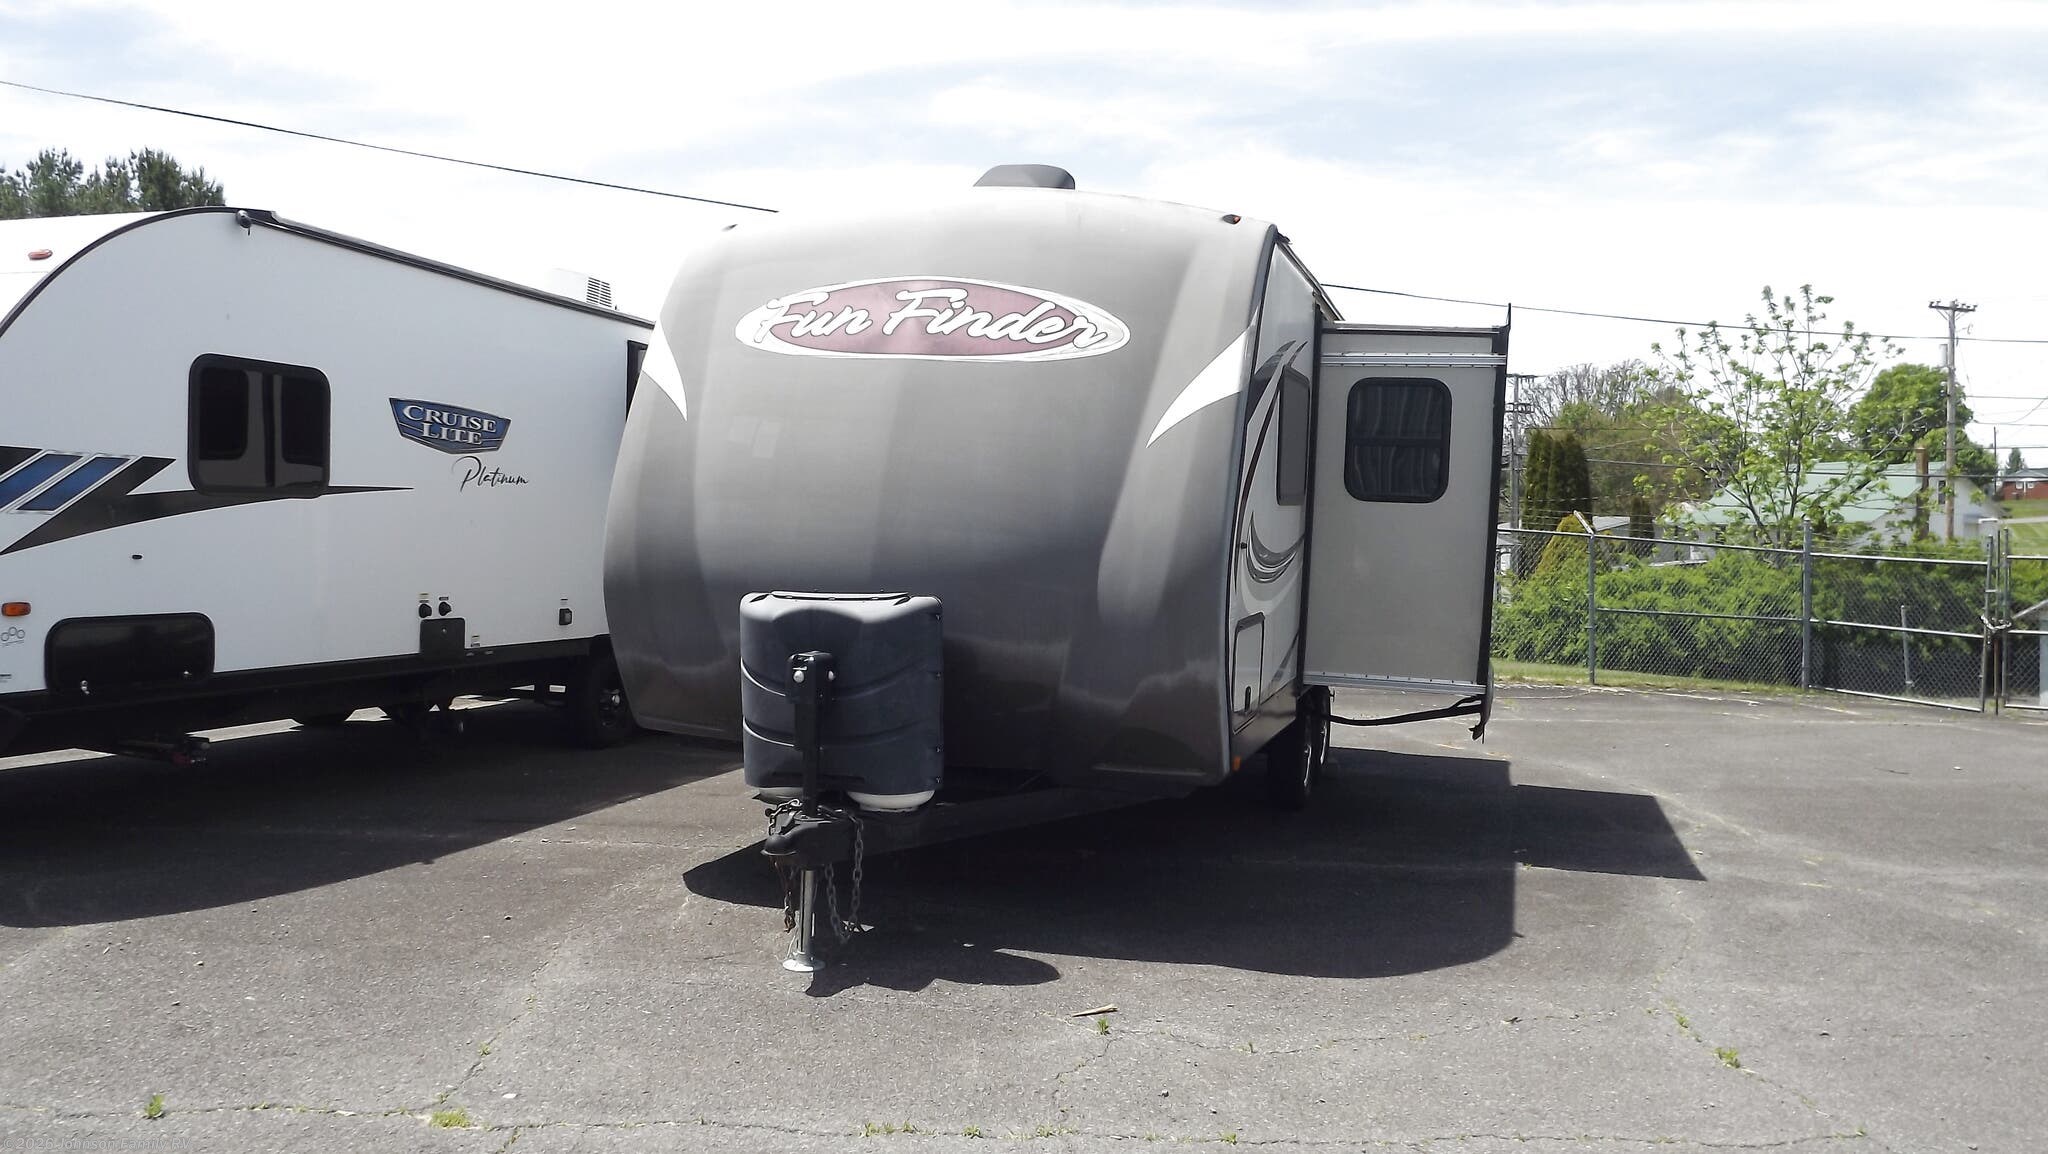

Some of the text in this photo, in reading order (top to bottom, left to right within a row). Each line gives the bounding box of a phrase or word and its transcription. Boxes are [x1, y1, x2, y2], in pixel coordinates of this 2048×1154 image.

[754, 288, 1109, 348] Fun Finder
[402, 405, 497, 434] CRUISE
[422, 422, 483, 446] LITE
[451, 455, 530, 493] Platinum
